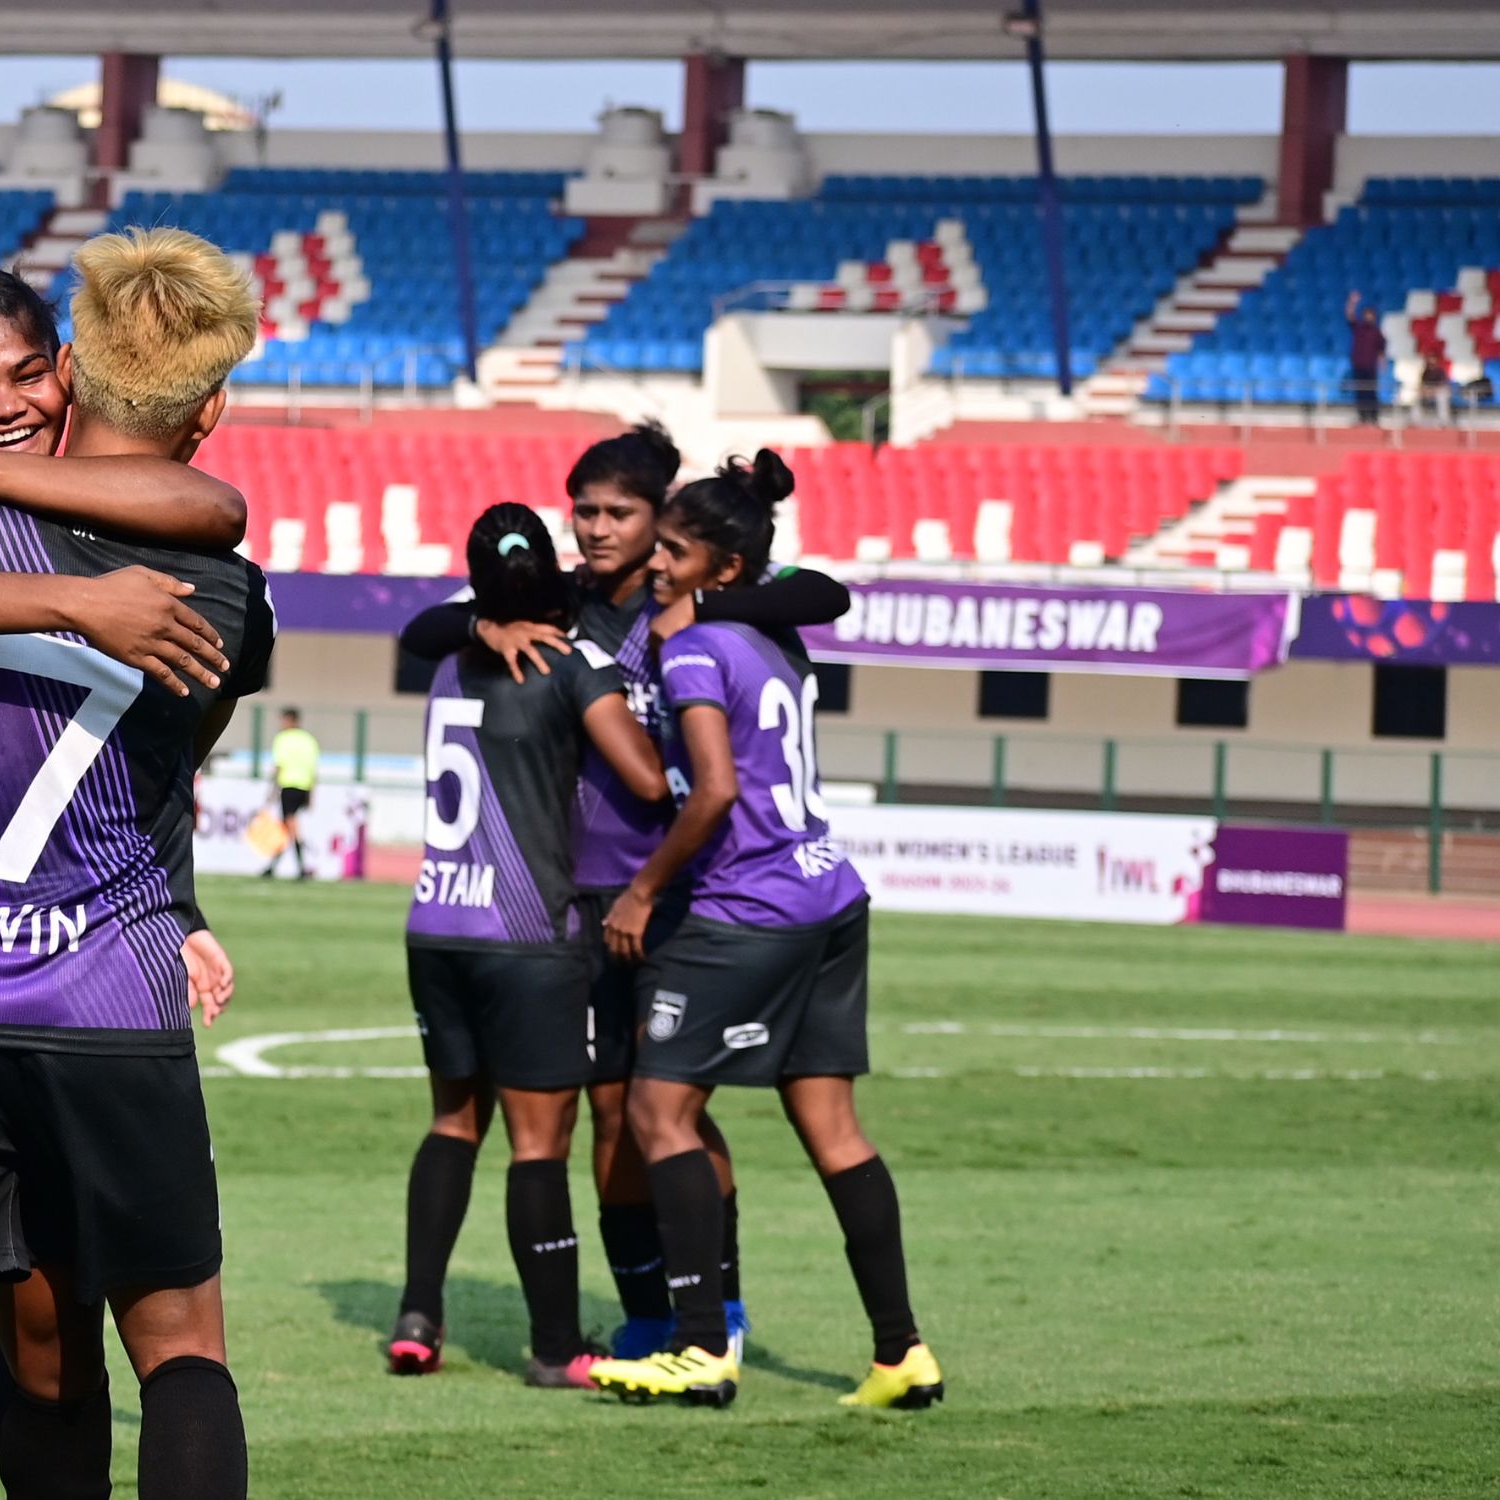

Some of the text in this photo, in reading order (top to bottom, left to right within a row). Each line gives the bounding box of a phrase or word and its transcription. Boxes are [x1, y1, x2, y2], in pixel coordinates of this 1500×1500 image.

[834, 591, 1162, 652] BHUBANESWAR
[995, 843, 1079, 869] LEAGUE
[415, 858, 495, 909] STAM
[1216, 868, 1343, 899] BHUBANESWAR
